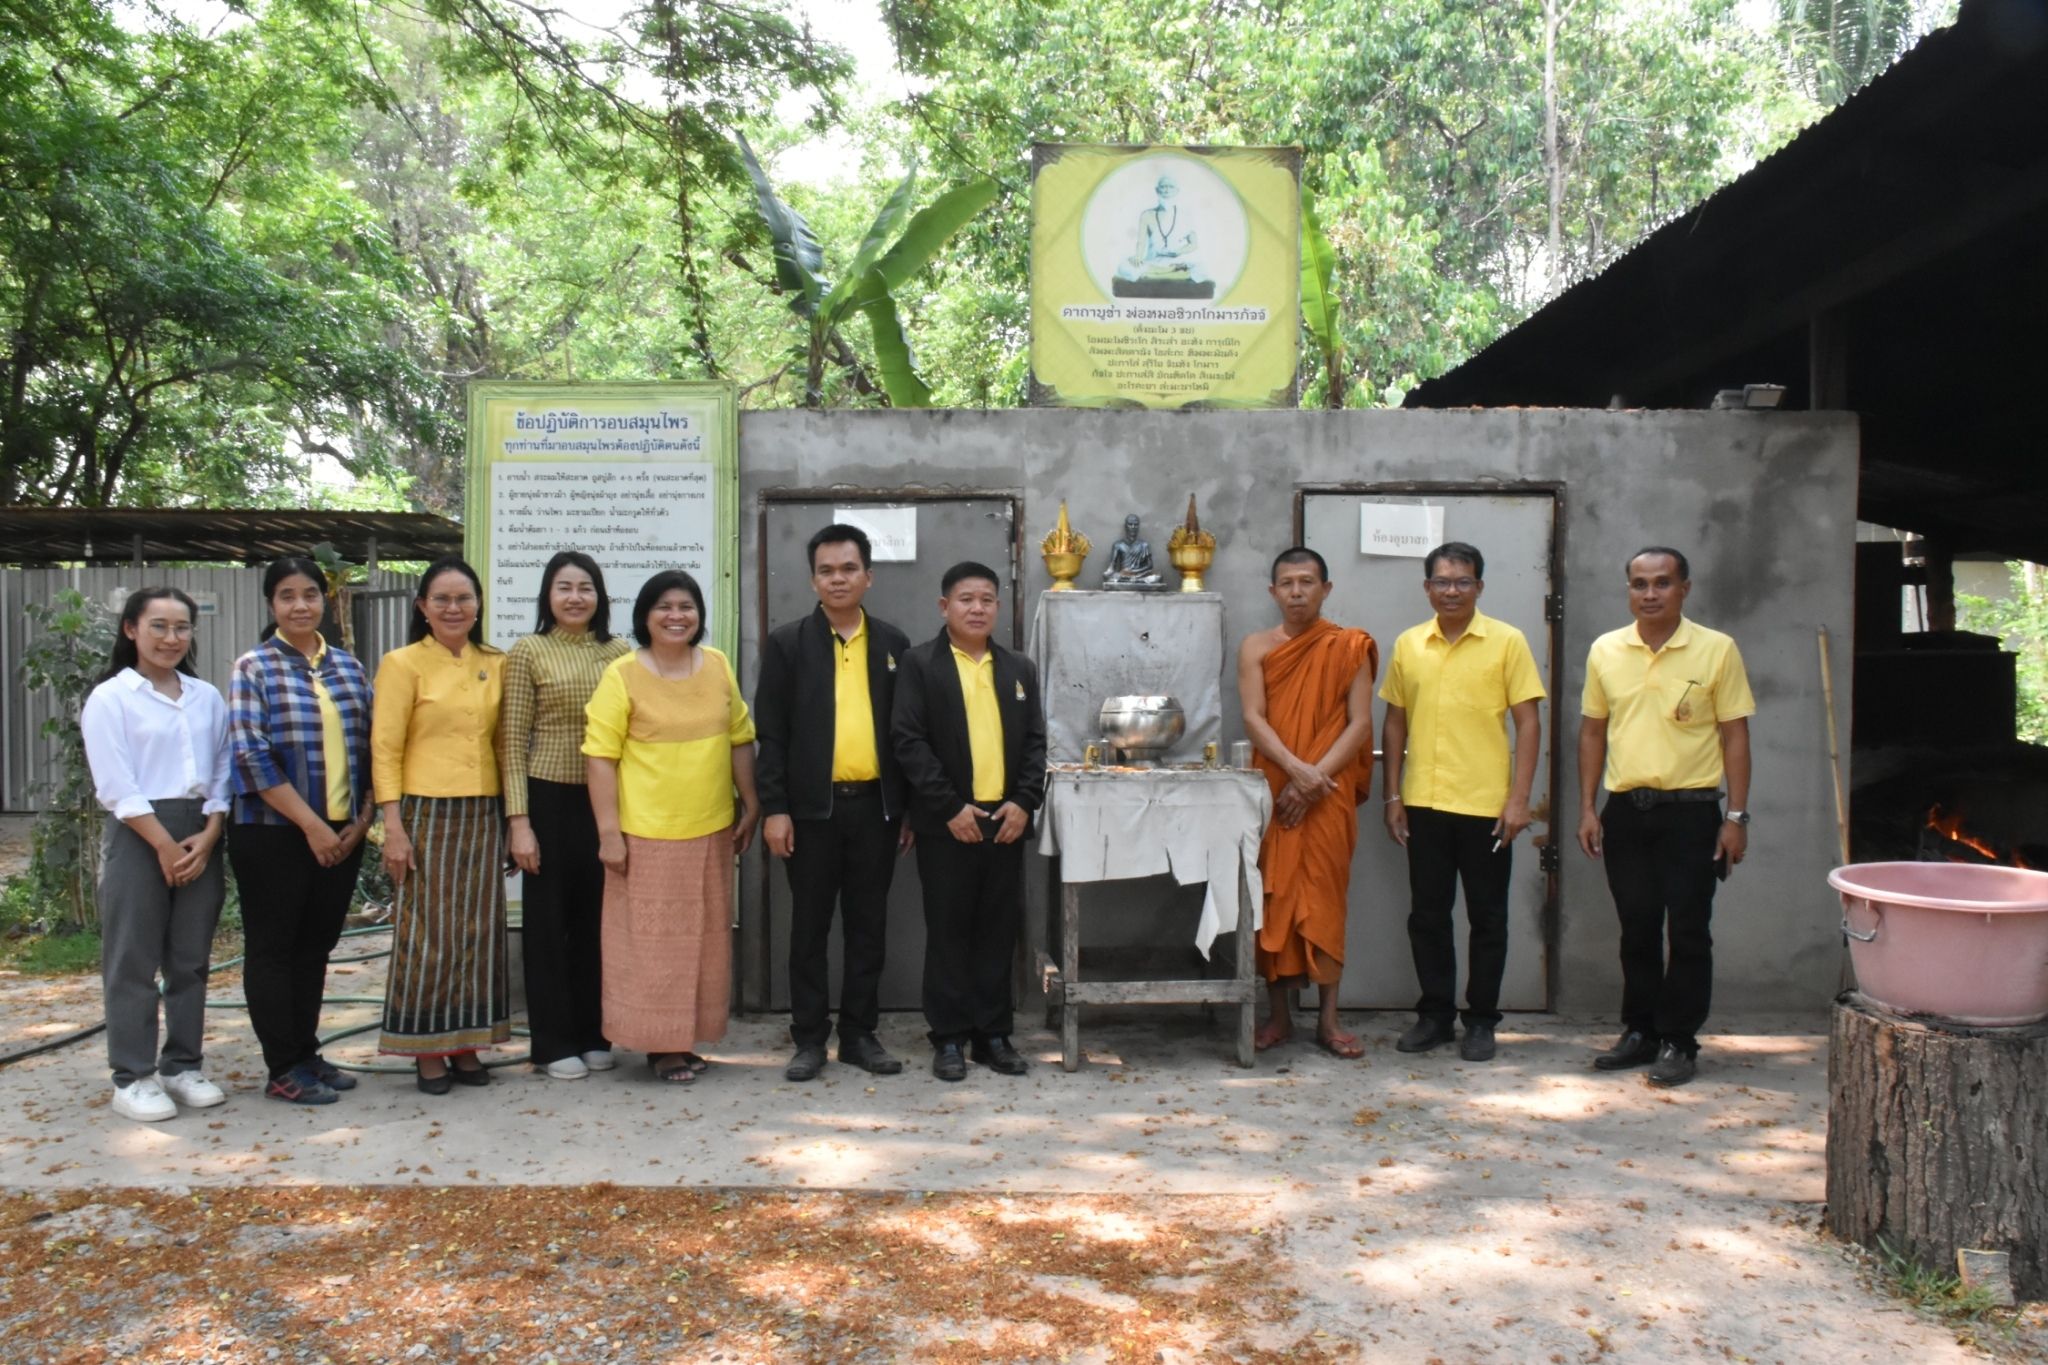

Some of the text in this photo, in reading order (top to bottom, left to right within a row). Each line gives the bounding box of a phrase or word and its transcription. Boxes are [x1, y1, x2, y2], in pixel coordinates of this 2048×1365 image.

[516, 411, 689, 434] ข้อปฏิบัติการอบสมุนไพร
